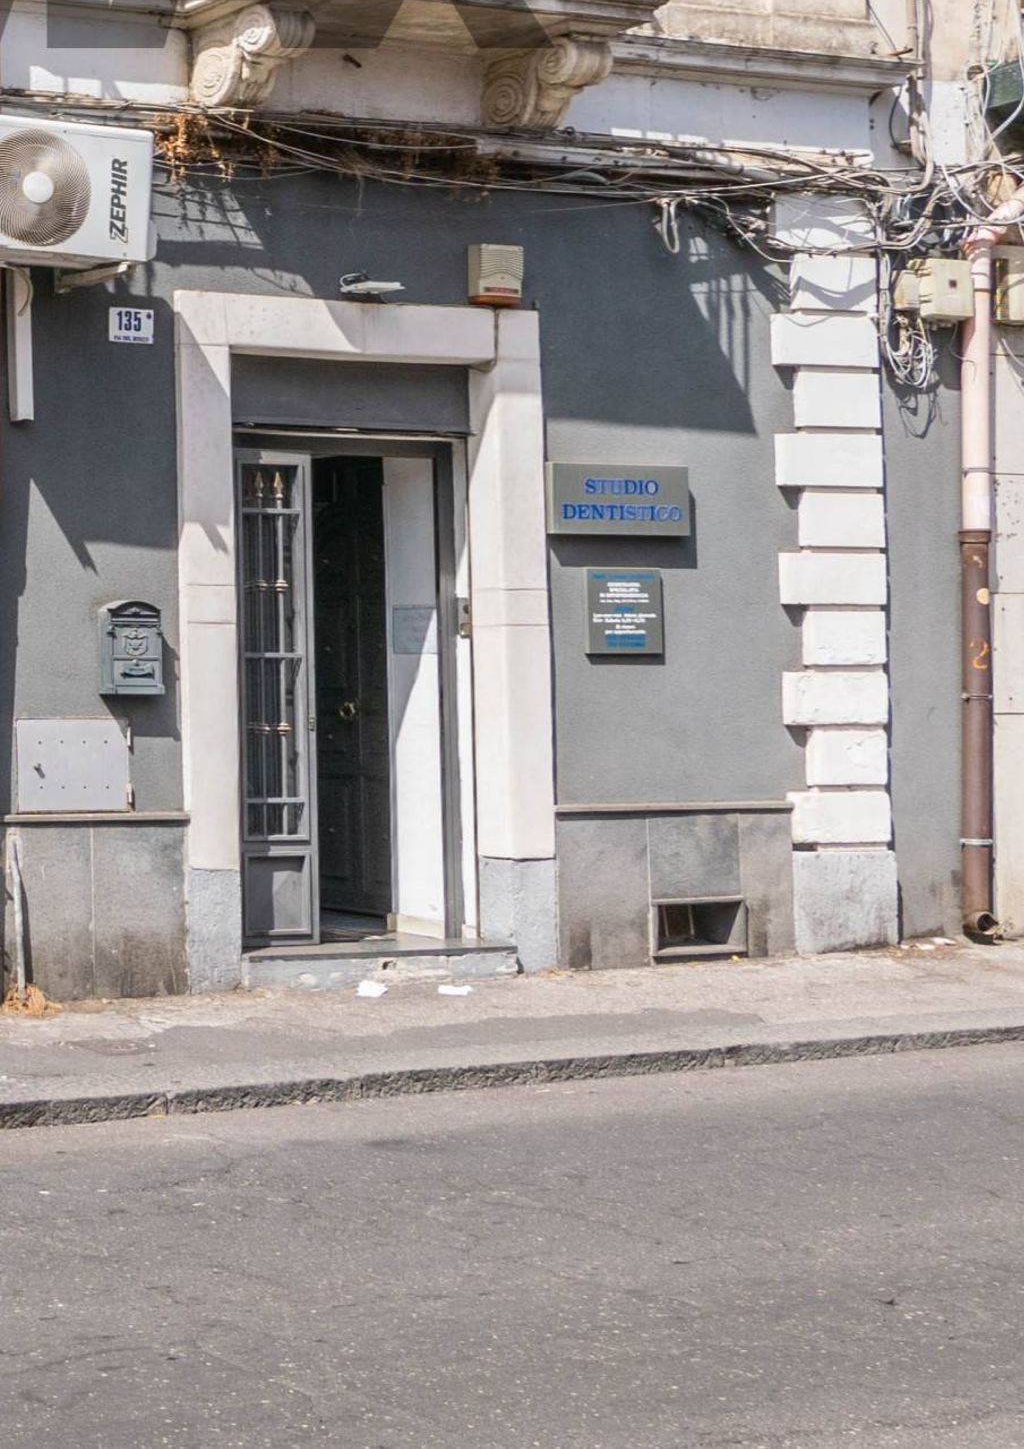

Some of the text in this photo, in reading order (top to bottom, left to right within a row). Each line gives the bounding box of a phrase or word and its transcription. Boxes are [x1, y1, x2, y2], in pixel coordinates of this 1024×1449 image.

[109, 157, 129, 244] ZEPHIR
[117, 311, 142, 332] 135
[584, 478, 659, 496] STUDIO
[562, 503, 683, 523] DENTISTICO
